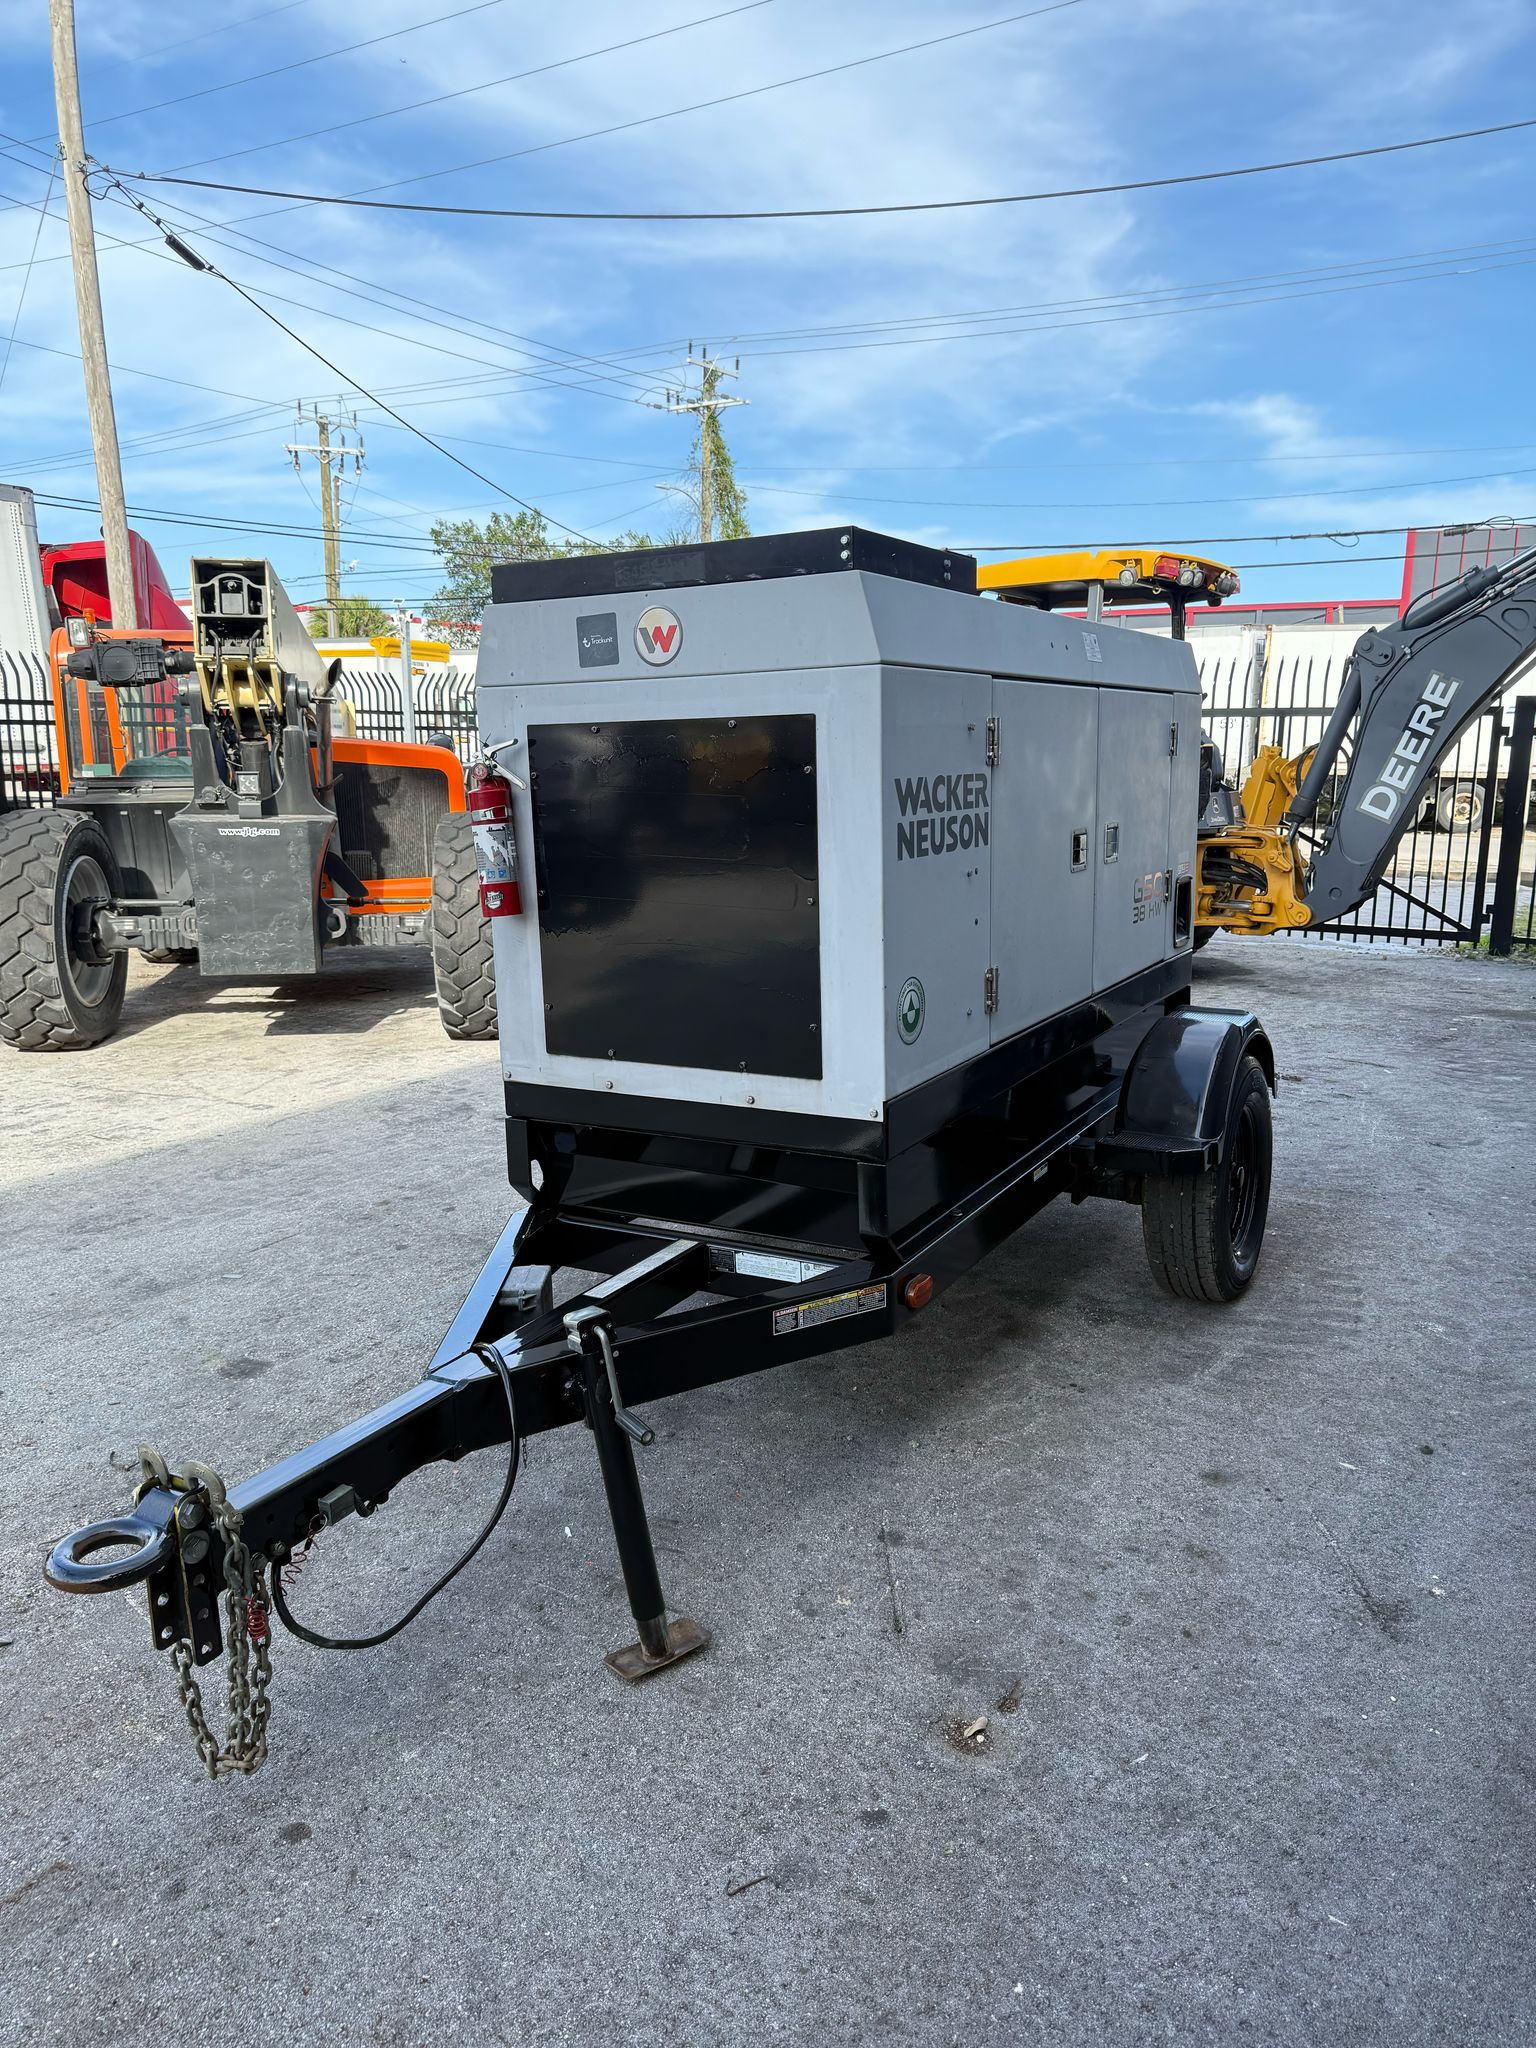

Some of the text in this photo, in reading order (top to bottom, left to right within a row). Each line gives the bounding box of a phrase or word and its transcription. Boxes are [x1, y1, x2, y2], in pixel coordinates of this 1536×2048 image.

[1360, 673, 1459, 820] DEERE
[894, 773, 989, 817] WACKER
[217, 827, 280, 837] www.jlg.com
[897, 812, 989, 861] NEUSON
[1132, 904, 1146, 924] 38
